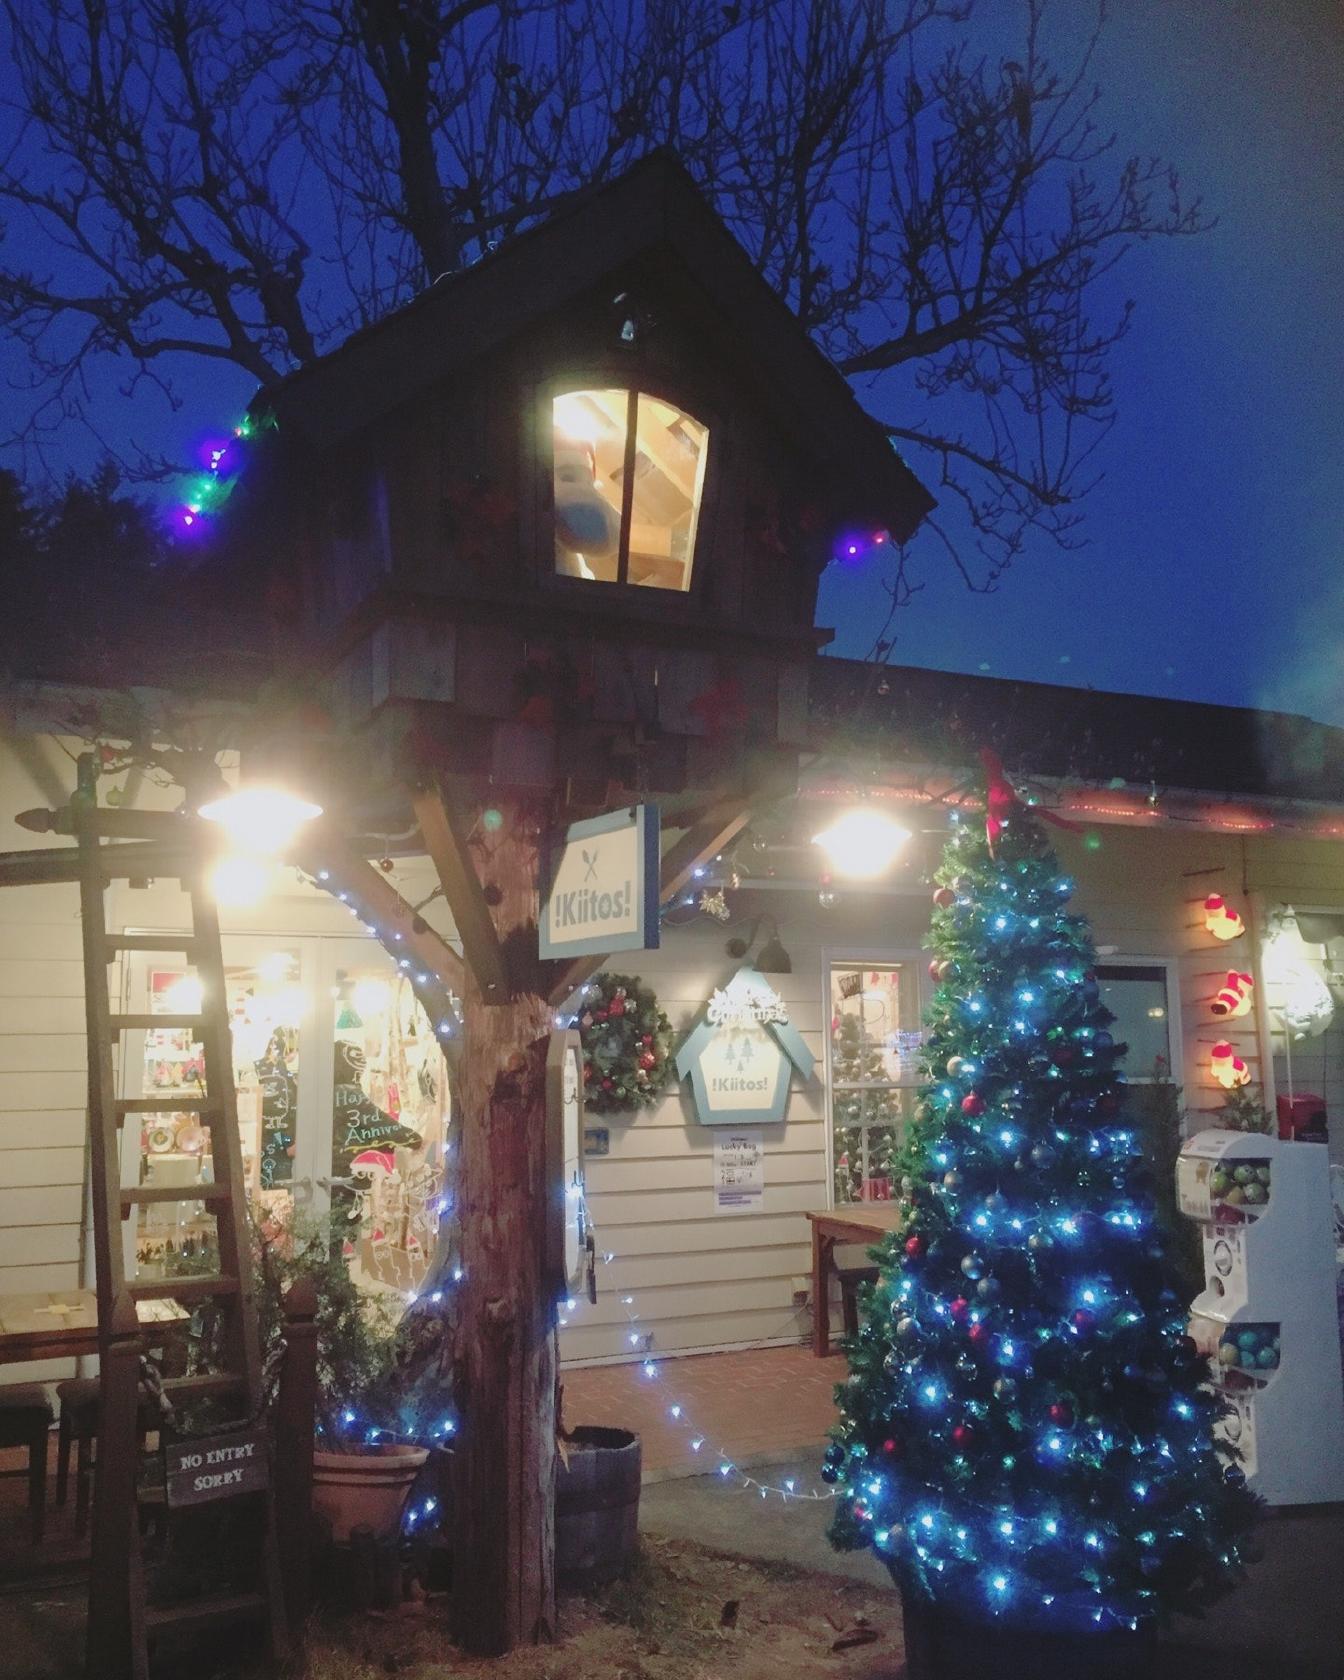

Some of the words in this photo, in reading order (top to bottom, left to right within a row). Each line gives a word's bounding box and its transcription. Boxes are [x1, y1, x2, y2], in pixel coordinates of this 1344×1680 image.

[555, 881, 632, 928] !Kiitos!
[712, 1077, 768, 1092] !Kiitos!
[346, 1107, 382, 1128] 3rd
[180, 1454, 202, 1470] NO
[206, 1443, 255, 1464] ENTRY
[193, 1468, 245, 1491] SORRY
